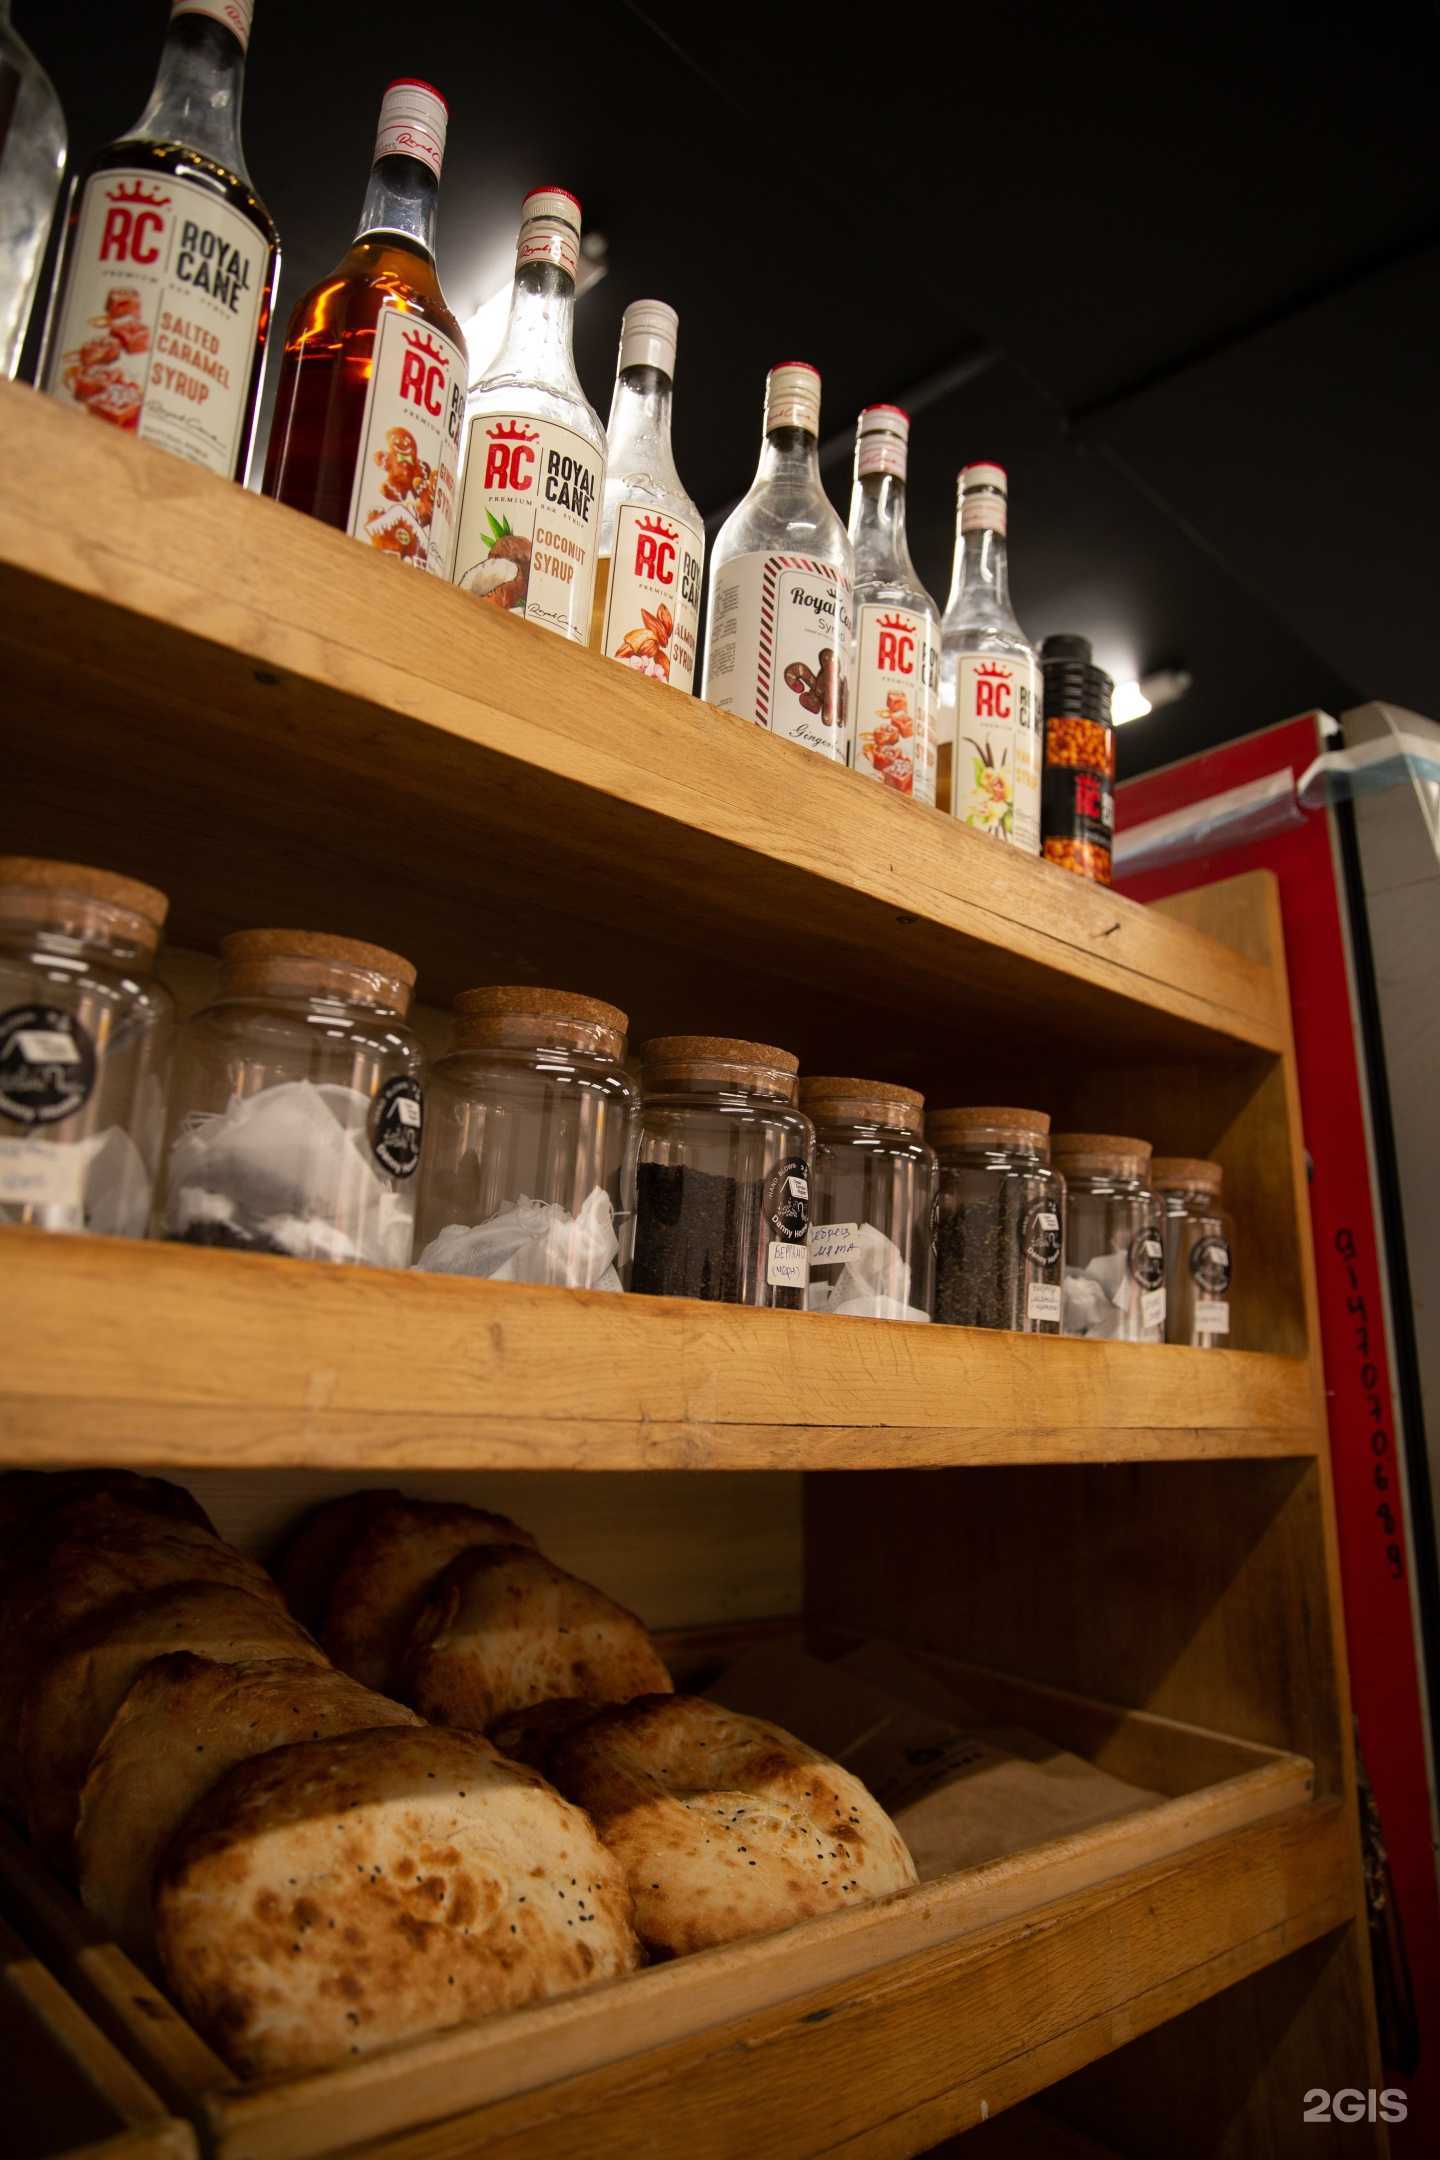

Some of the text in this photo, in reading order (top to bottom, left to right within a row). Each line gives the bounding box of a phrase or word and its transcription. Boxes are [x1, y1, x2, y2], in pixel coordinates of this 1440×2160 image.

[99, 208, 164, 264] RC
[182, 221, 250, 290] ROYAL
[176, 251, 240, 314] CANE
[161, 311, 220, 354] SALTED
[151, 362, 210, 406] SYRUP
[157, 334, 231, 390] CARAMEL
[400, 349, 446, 417] RC
[484, 443, 535, 491] RC
[547, 449, 595, 501] ROYAL
[488, 496, 533, 506] PREMIUM
[545, 476, 591, 523] CANE
[533, 552, 574, 585] SYRUP
[536, 528, 587, 567] COCONUT
[634, 534, 676, 585] RC
[790, 587, 836, 616] Royal
[877, 631, 914, 675] RC
[976, 680, 1012, 718] RC
[772, 1214, 793, 1238] Danny
